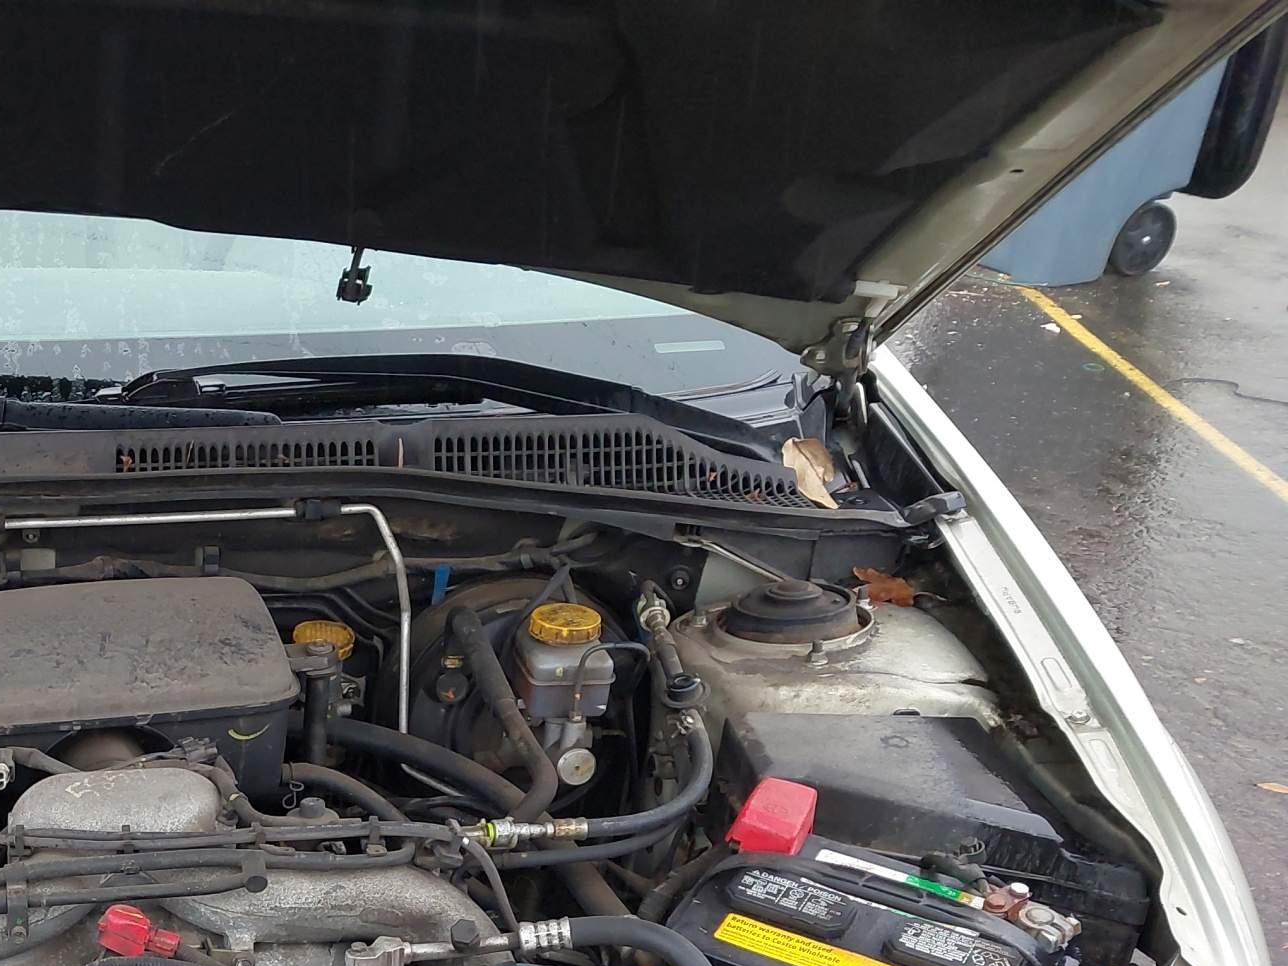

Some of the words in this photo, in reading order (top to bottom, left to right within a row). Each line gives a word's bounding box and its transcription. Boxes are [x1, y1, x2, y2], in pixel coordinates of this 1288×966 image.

[761, 871, 799, 889] DANGER
[807, 886, 842, 902] POISON
[726, 922, 760, 938] batteries
[762, 933, 770, 941] to
[772, 937, 797, 950] Costco
[798, 946, 840, 964] Wholesale
[731, 916, 758, 929] Return
[758, 926, 794, 942] warranty
[795, 938, 812, 948] and
[812, 943, 833, 954] used
